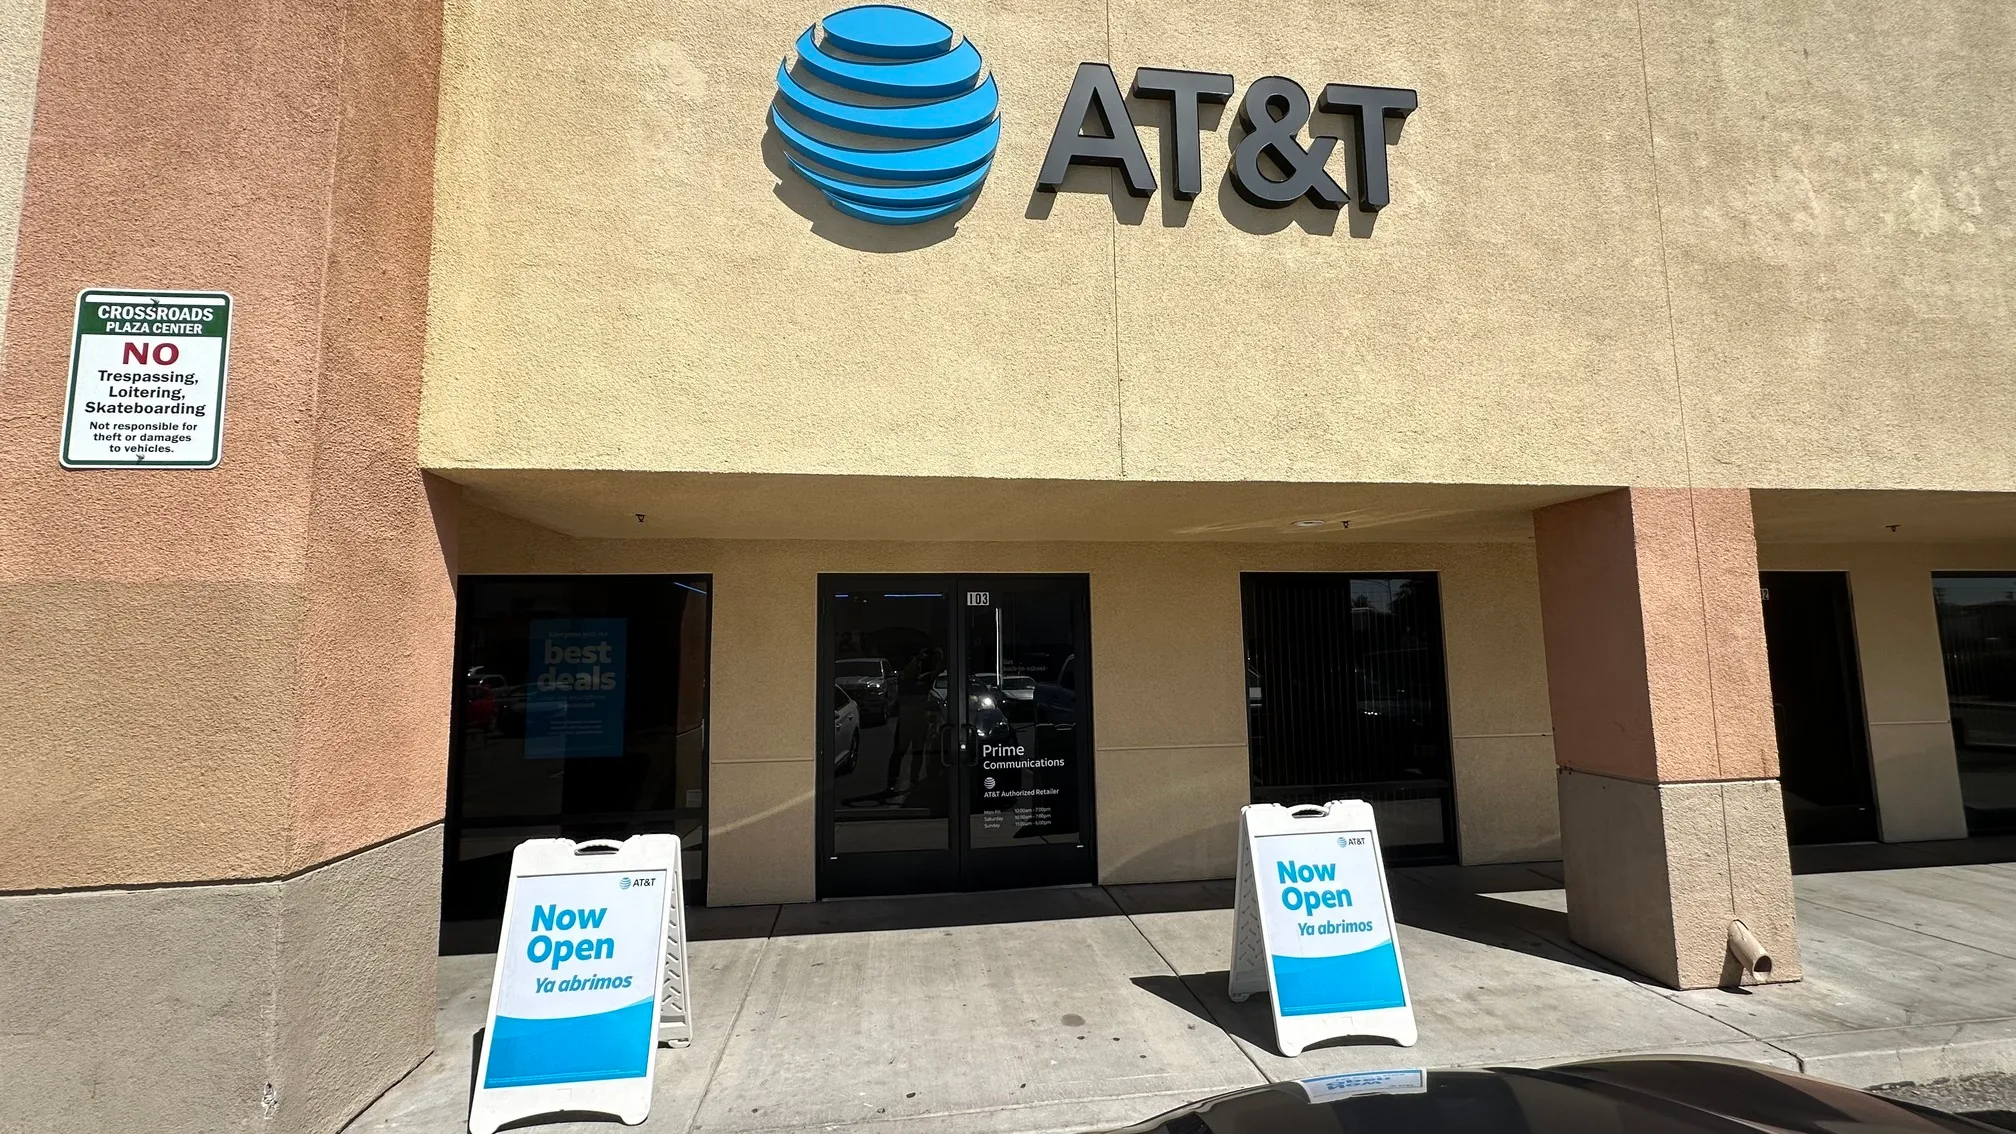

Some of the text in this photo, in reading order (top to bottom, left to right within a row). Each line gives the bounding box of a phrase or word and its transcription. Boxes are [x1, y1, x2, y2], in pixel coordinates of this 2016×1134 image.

[1037, 62, 1418, 213] AT&T
[97, 305, 214, 321] CROSSROADS
[106, 322, 203, 334] PLAZA CENTER
[122, 342, 180, 365] NO
[97, 370, 199, 385] Trespassing,
[108, 386, 186, 400] Loitering,
[84, 401, 206, 417] Skateboarding
[89, 421, 198, 432] Not responsible for
[93, 432, 192, 443] theft or damages
[109, 444, 175, 453] to vehicles.
[968, 592, 989, 605] 103
[544, 640, 612, 664] best
[536, 665, 617, 691] deals
[983, 743, 1025, 757] Prime
[983, 758, 1065, 770] Communications
[984, 788, 1060, 798] AT&T Authorized Retailer
[1348, 837, 1366, 846] AT&T
[1276, 860, 1336, 884] Now
[632, 877, 656, 888] AT&T
[1281, 886, 1353, 916] Open
[530, 904, 607, 931] Now
[1297, 919, 1373, 936] Ya abrimos
[526, 935, 615, 970] Open
[534, 974, 633, 993] Ya abrimos
